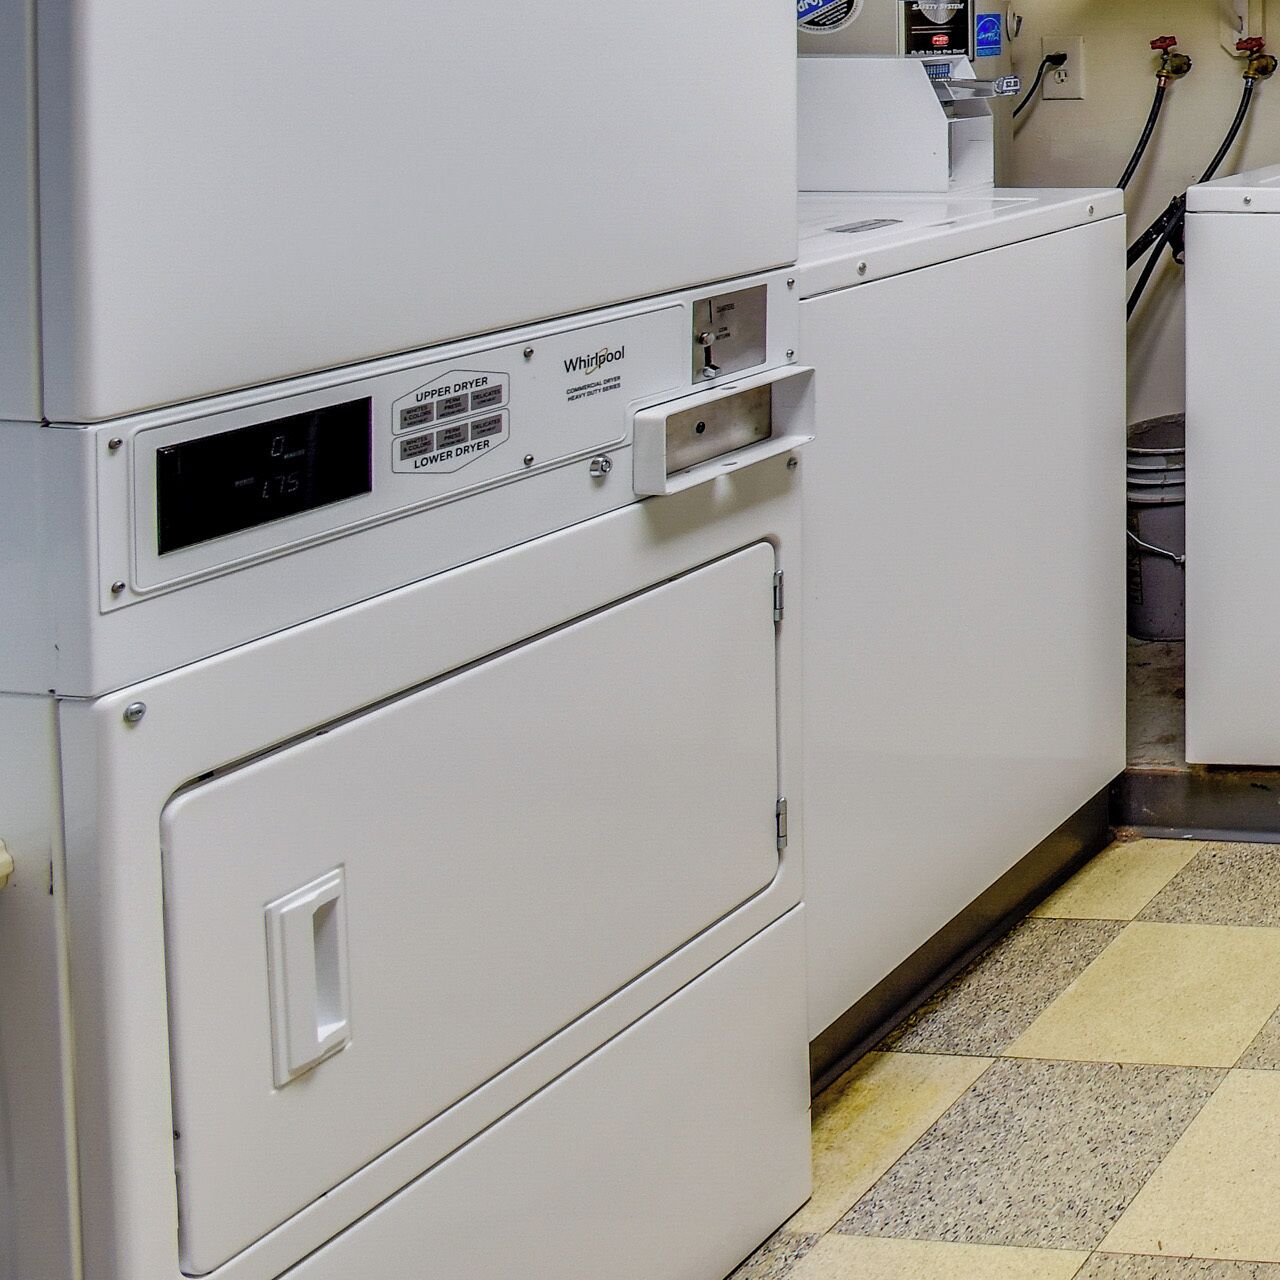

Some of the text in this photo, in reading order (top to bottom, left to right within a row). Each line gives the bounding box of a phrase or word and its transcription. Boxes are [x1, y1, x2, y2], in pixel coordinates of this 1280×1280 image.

[564, 346, 624, 373] Whirlpool
[416, 377, 488, 402] UPPER DRYER
[567, 376, 620, 394] COMMERCIAL DRYER
[473, 389, 501, 400] DELICATES
[568, 383, 620, 401] HEAVY DUTY SERIES
[407, 405, 428, 414] WHITES
[445, 402, 462, 410] PRESS
[409, 411, 431, 420] COLORS
[473, 419, 501, 429] DELICATES
[406, 436, 428, 445] WHITES
[409, 442, 431, 450] COLORS
[271, 436, 285, 457] 0
[415, 440, 490, 469] LOWER DRYER
